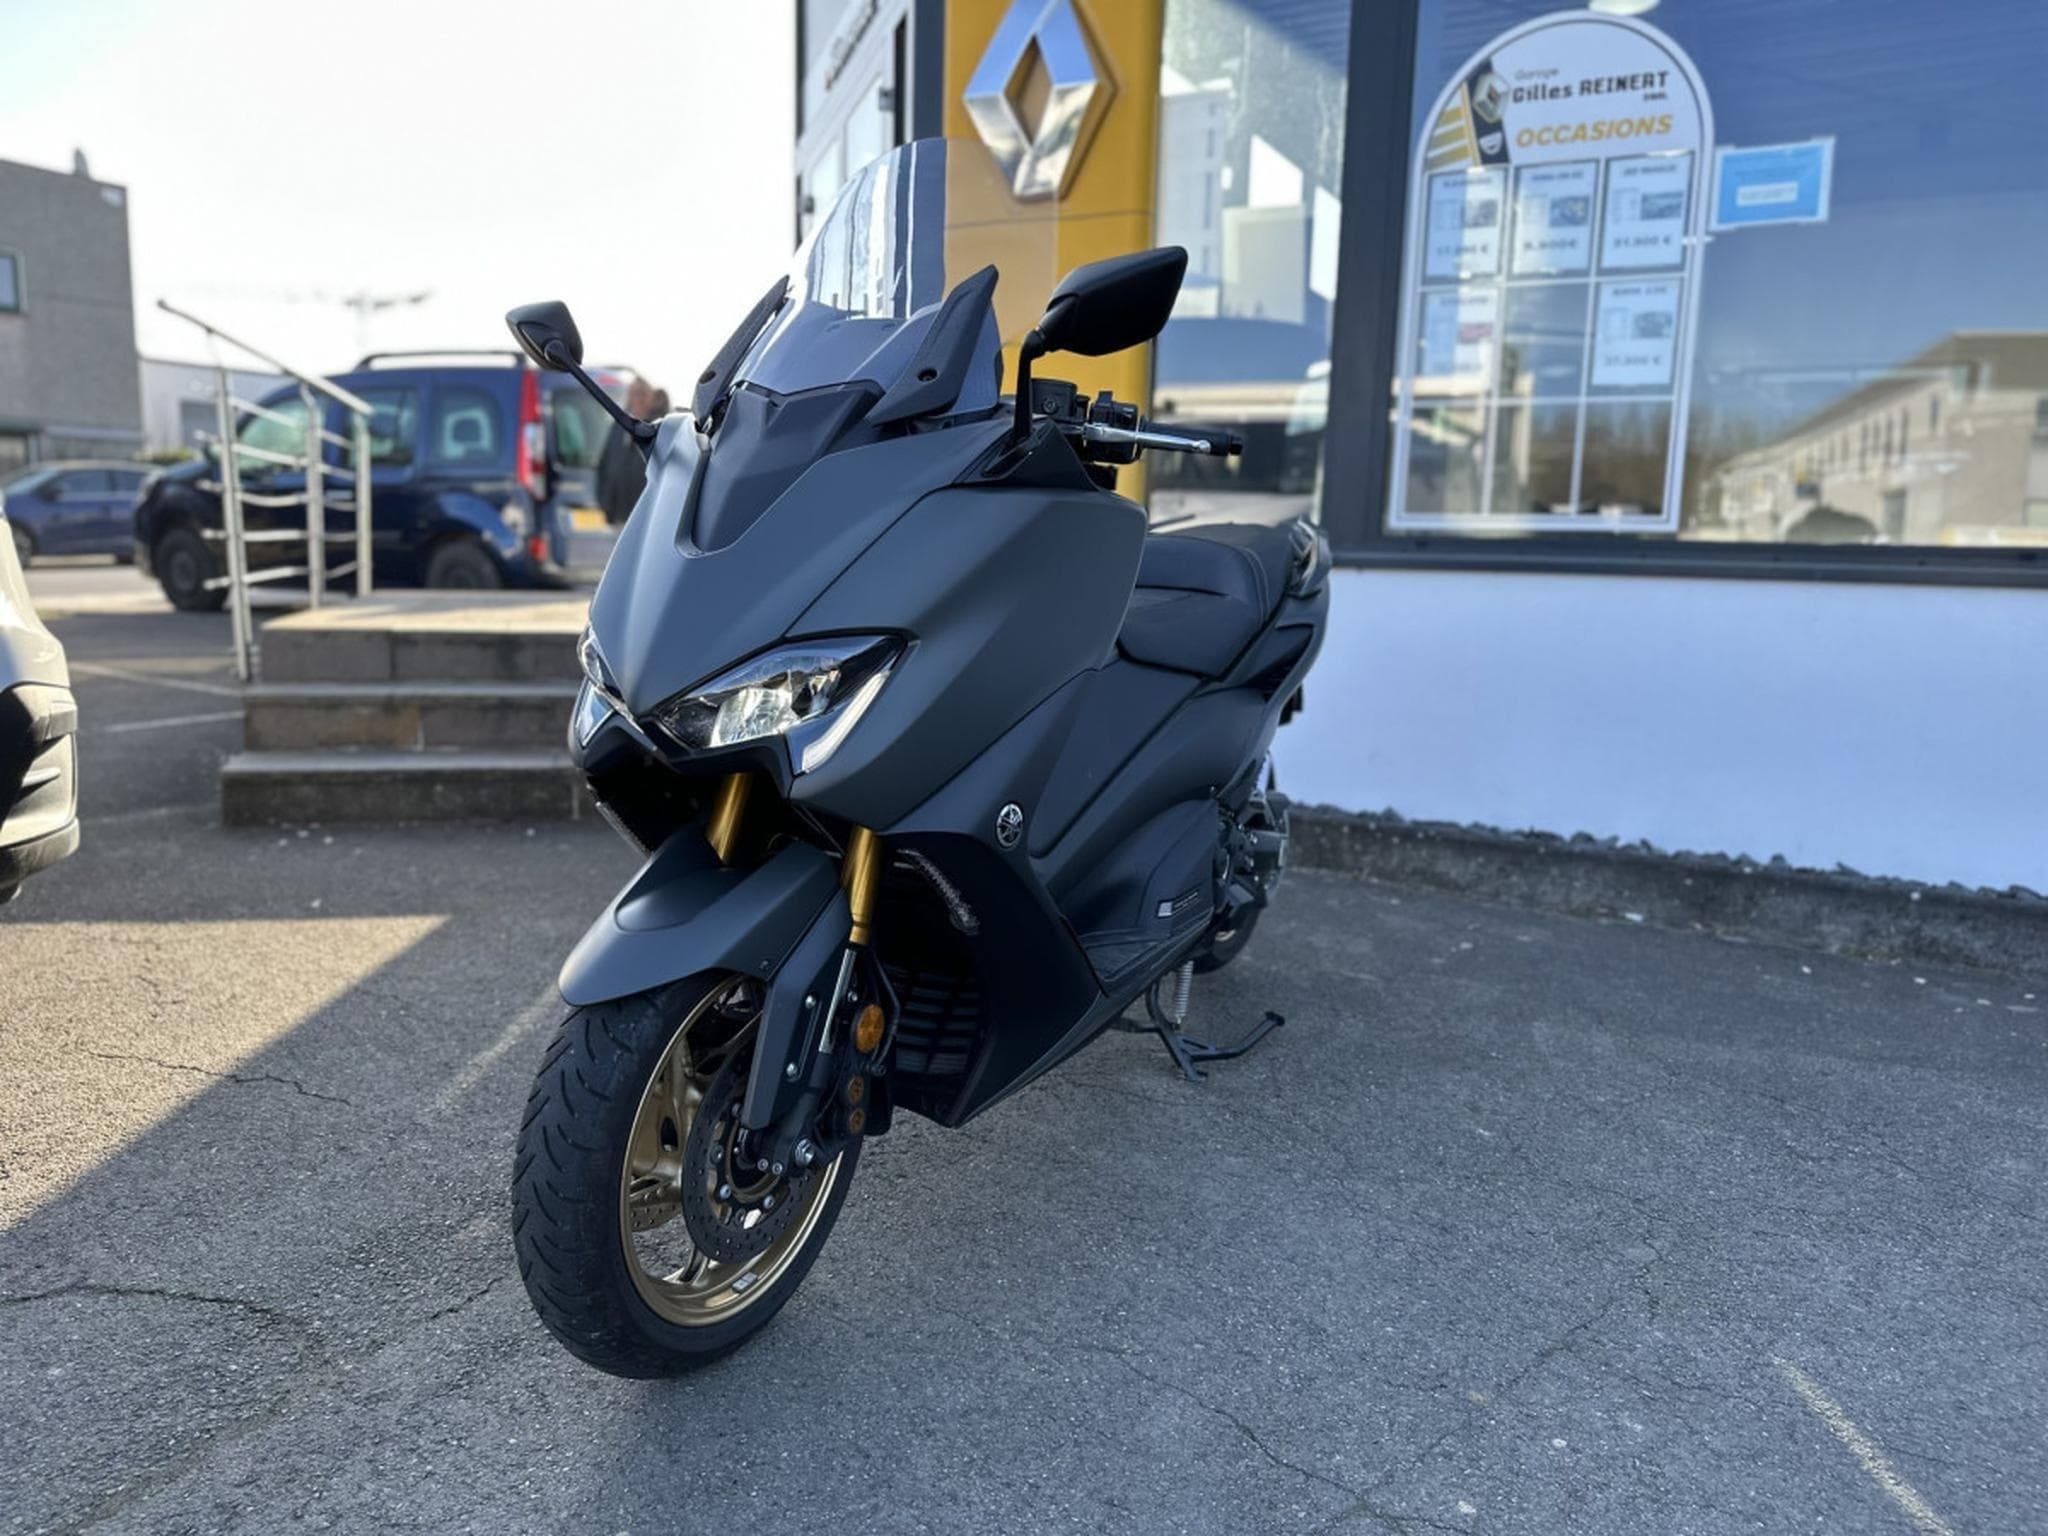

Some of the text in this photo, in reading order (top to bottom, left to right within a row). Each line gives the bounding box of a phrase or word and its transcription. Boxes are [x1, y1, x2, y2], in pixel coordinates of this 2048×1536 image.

[1512, 71, 1669, 103] Gilles REINERT
[1516, 114, 1673, 148] OCCASIONS
